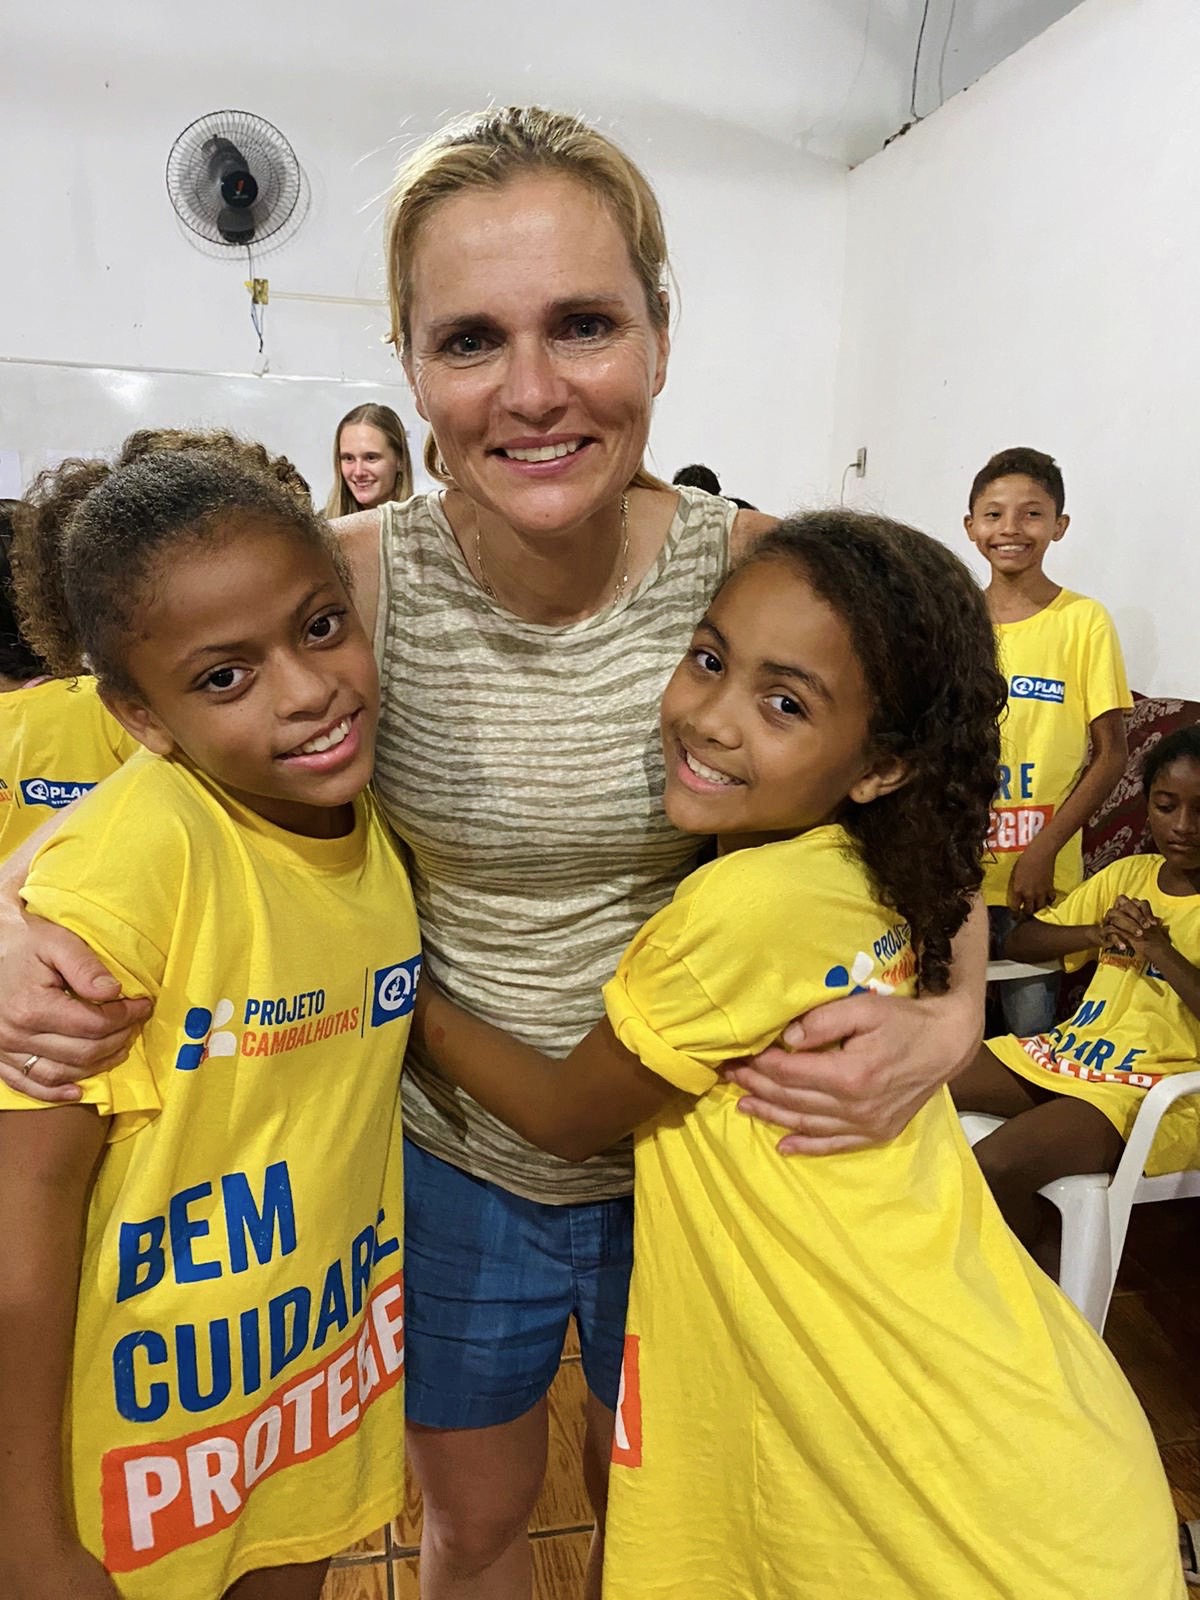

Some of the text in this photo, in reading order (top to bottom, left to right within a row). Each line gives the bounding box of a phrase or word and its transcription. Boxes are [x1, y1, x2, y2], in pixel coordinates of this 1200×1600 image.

[1034, 680, 1064, 696] PLAN
[244, 989, 325, 1026] PROJETO
[241, 1006, 369, 1058] CAMBALHOTAS
[116, 1160, 297, 1304] BEM
